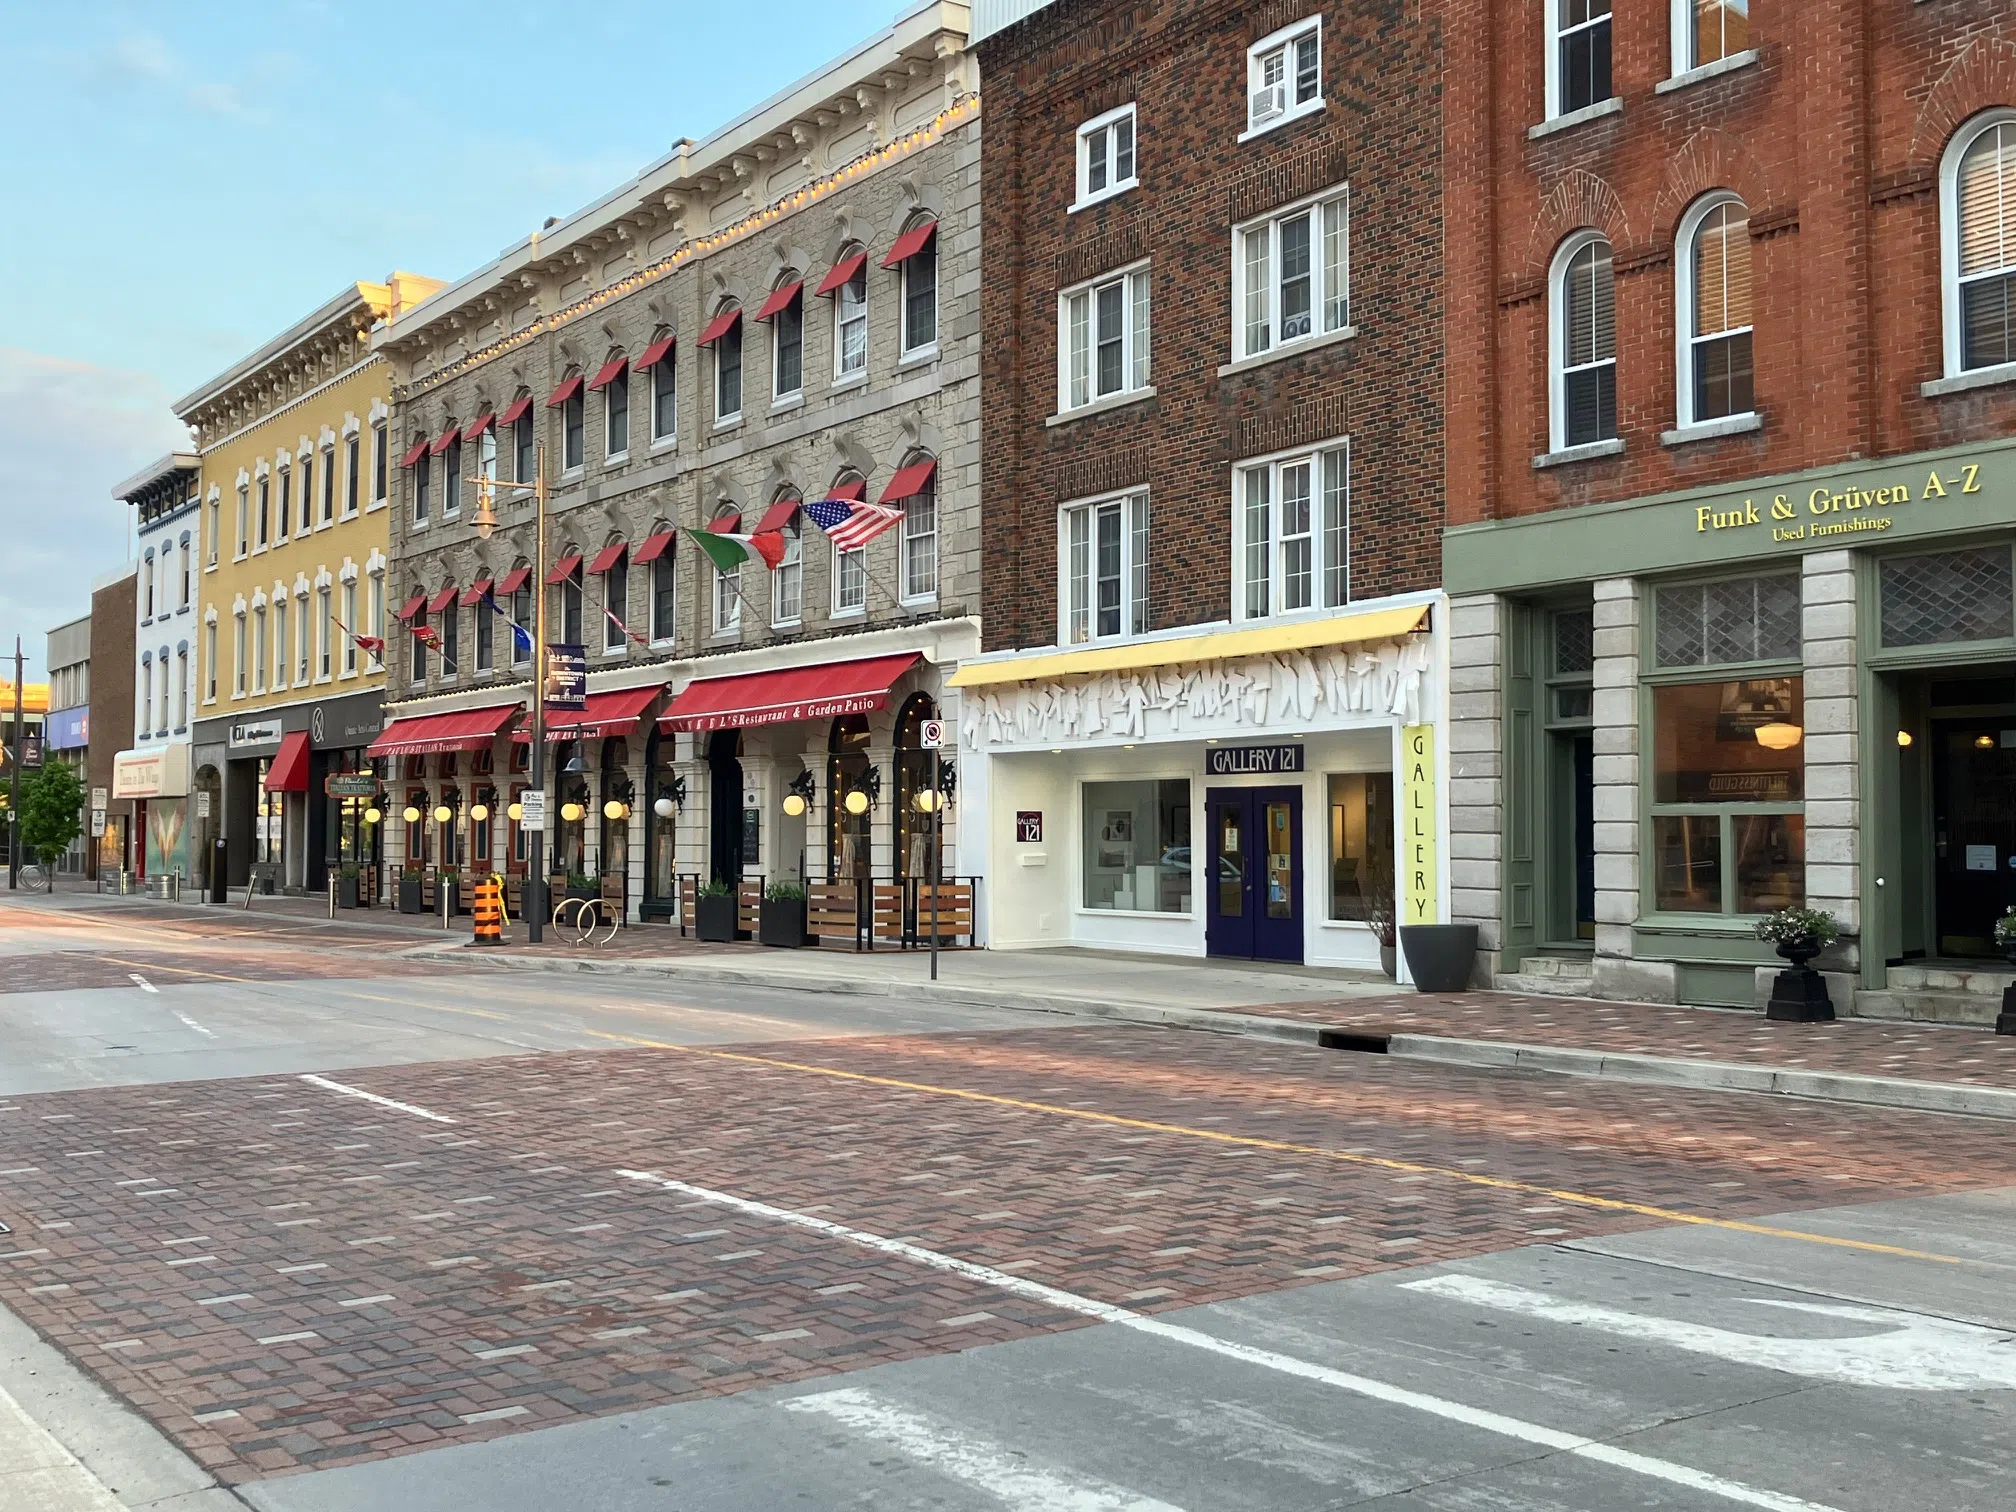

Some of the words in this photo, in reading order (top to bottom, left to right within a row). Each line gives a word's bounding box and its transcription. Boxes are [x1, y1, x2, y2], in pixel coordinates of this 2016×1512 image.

[1695, 499, 1760, 532] Funk
[1771, 494, 1798, 520] &
[1808, 485, 1910, 515] Grüven
[1922, 464, 1981, 500] A-Z
[1773, 526, 1805, 542] Used
[1810, 515, 1892, 538] Furnishings
[739, 710, 787, 725] Restaurant
[793, 706, 801, 718] &
[808, 702, 842, 716] Garden
[845, 698, 874, 712] Patio
[1213, 748, 1276, 773] GALLERY
[1280, 747, 1295, 770] 121
[1026, 824, 1040, 841] 121
[1413, 735, 1426, 917] GALLERY
